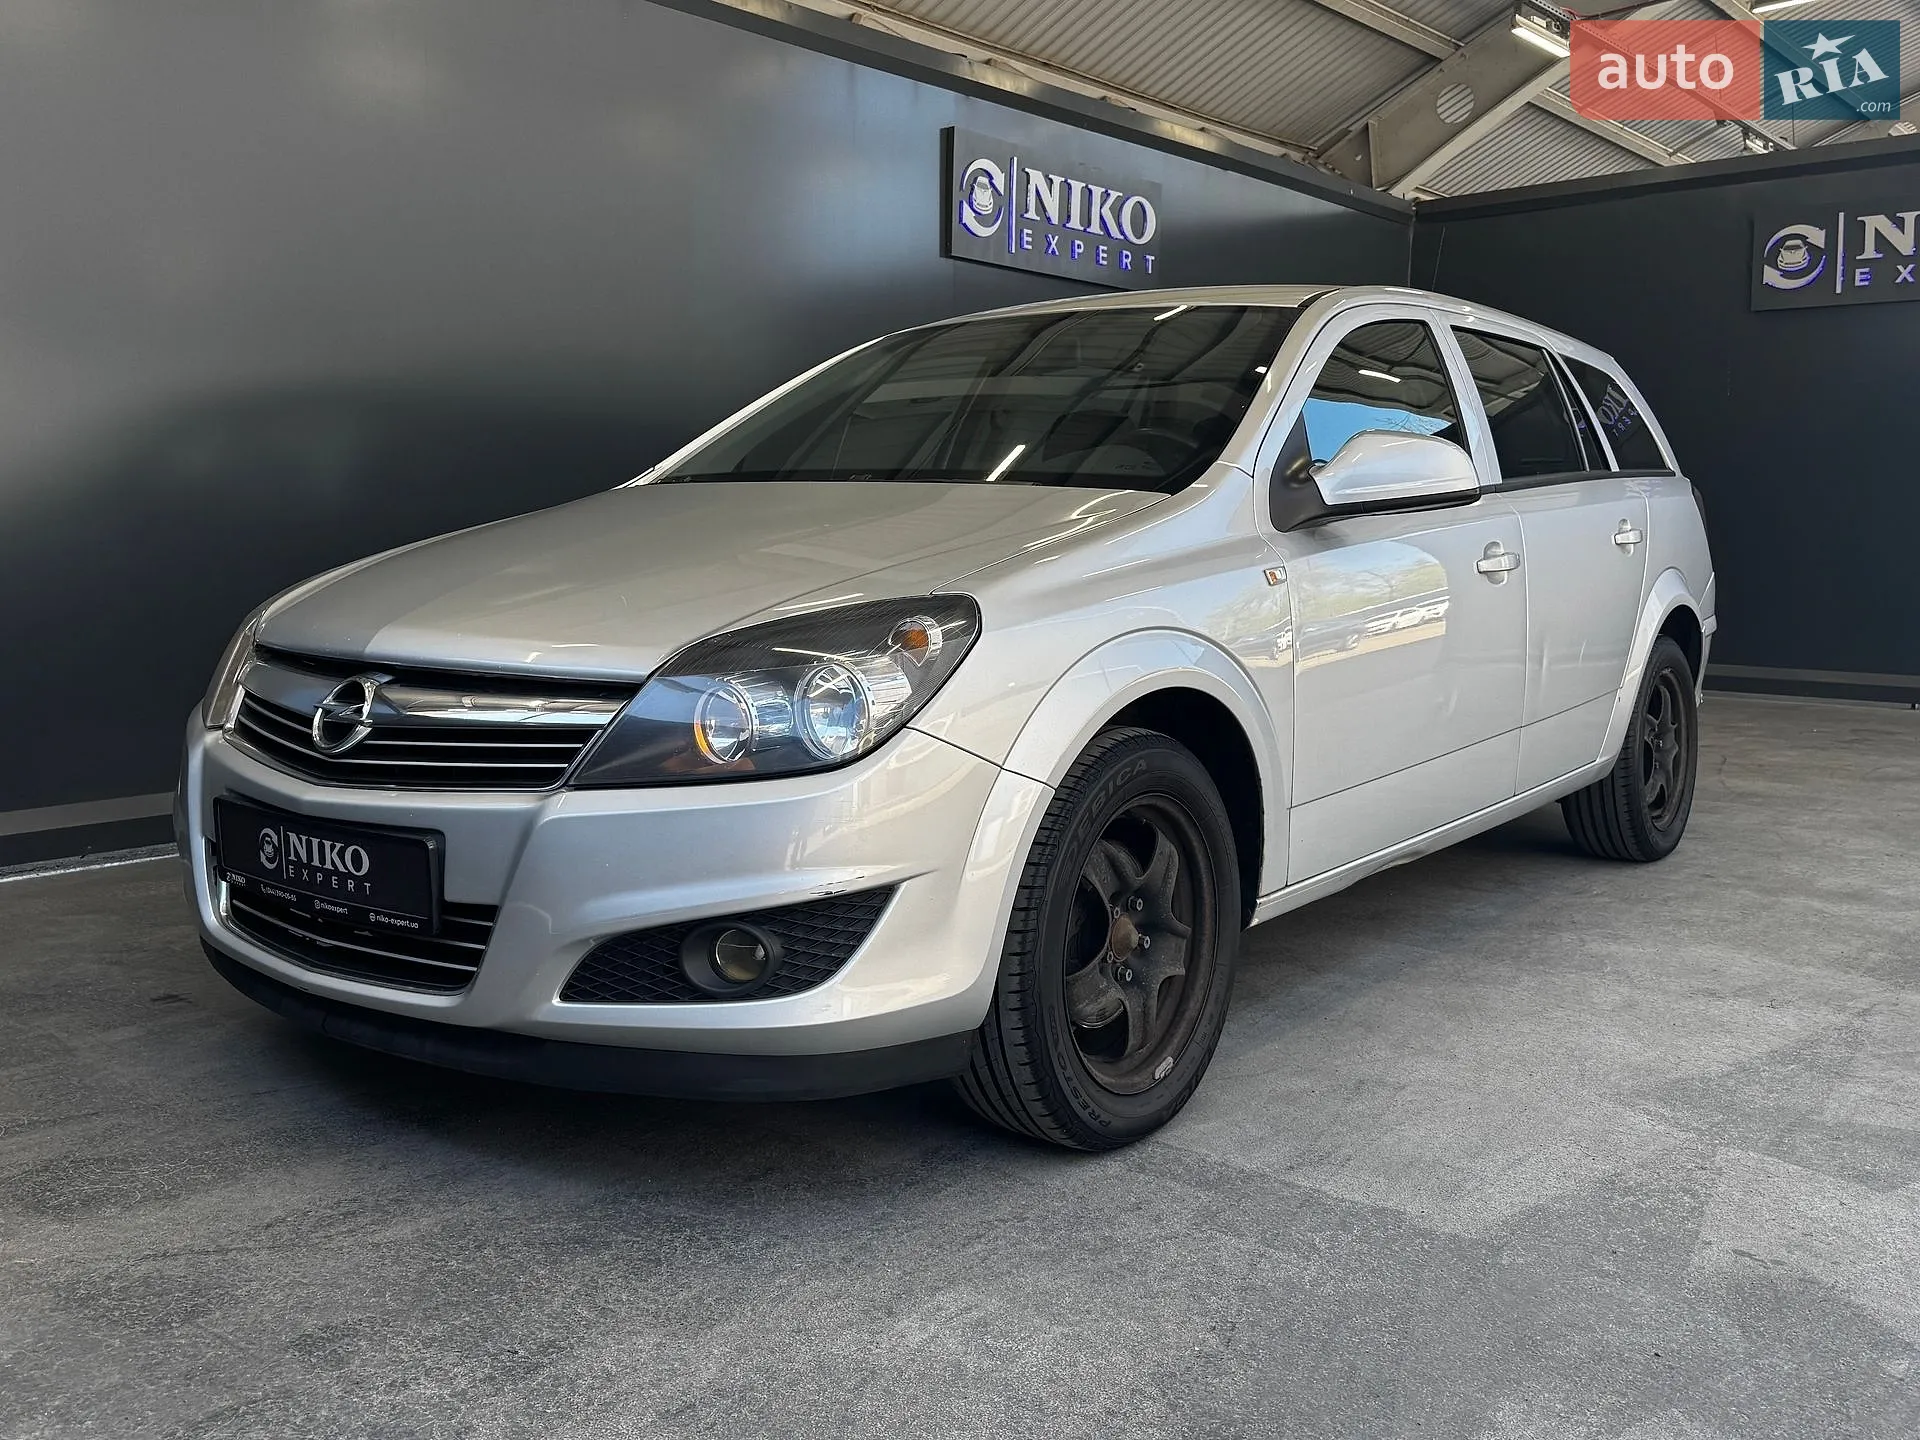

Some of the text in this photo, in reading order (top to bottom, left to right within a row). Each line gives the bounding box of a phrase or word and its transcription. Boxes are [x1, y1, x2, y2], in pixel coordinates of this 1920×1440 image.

[1020, 167, 1157, 245] NIKO
[1020, 229, 1155, 274] EXPERT
[287, 831, 370, 876] NIKO
[289, 865, 372, 896] EXPERT
